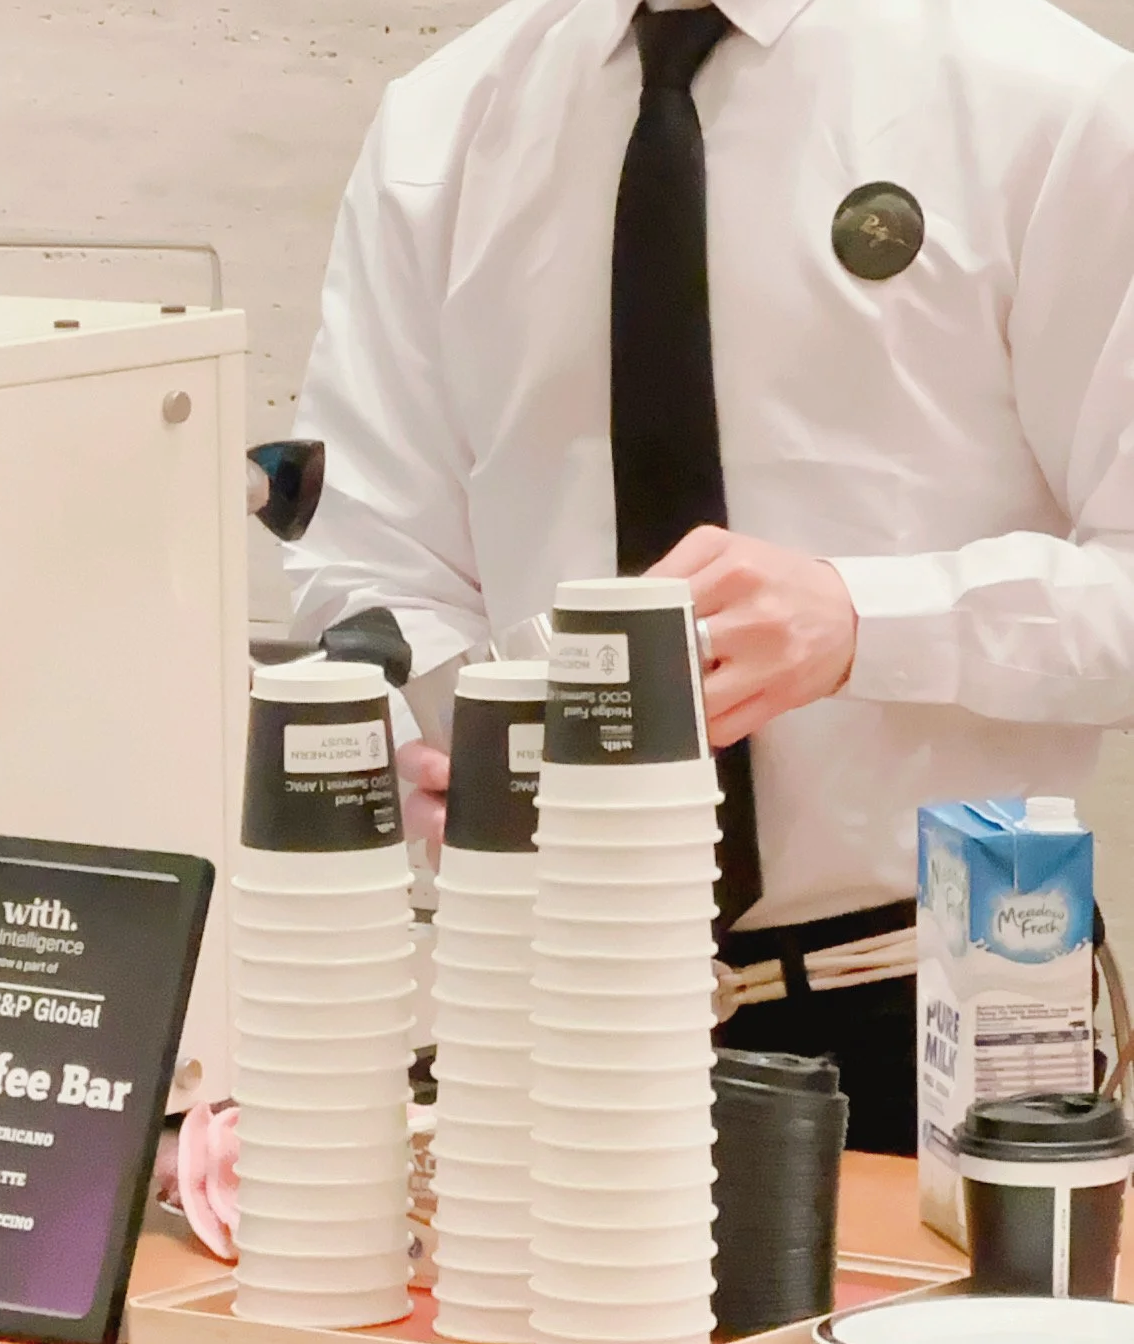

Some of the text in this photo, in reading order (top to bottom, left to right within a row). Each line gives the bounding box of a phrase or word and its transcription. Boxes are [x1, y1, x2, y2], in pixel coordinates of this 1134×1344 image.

[2, 896, 79, 932] with.
[997, 902, 1065, 934] Meadow
[1021, 918, 1061, 939] Fresh
[23, 959, 47, 973] part
[46, 961, 59, 975] of
[33, 997, 102, 1029] Global
[926, 998, 960, 1045] PURE
[924, 1031, 959, 1082] MILK
[56, 1063, 133, 1112] Bar
